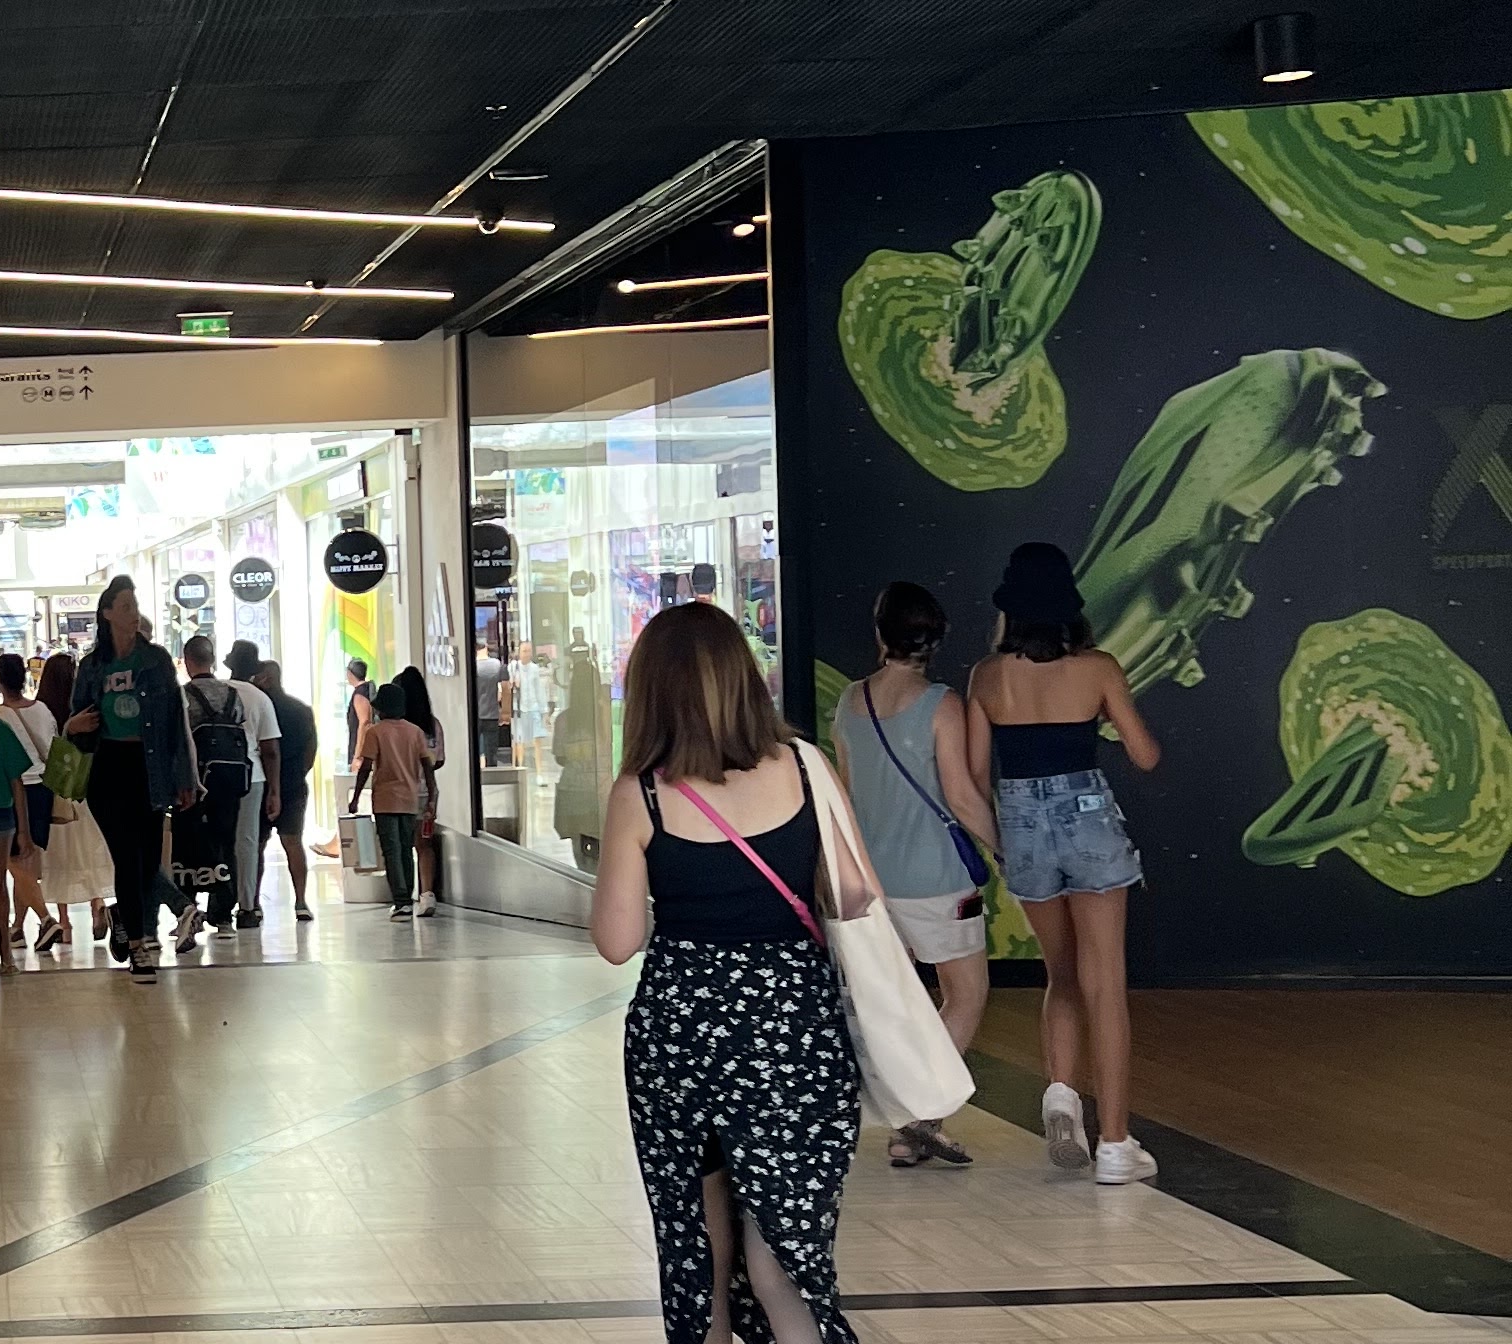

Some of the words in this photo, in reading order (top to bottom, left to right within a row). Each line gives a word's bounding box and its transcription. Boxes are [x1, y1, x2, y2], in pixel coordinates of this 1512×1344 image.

[232, 572, 273, 584] CLEOR
[59, 596, 89, 607] KIKO
[103, 669, 137, 693] UCL
[170, 861, 231, 887] fnac
